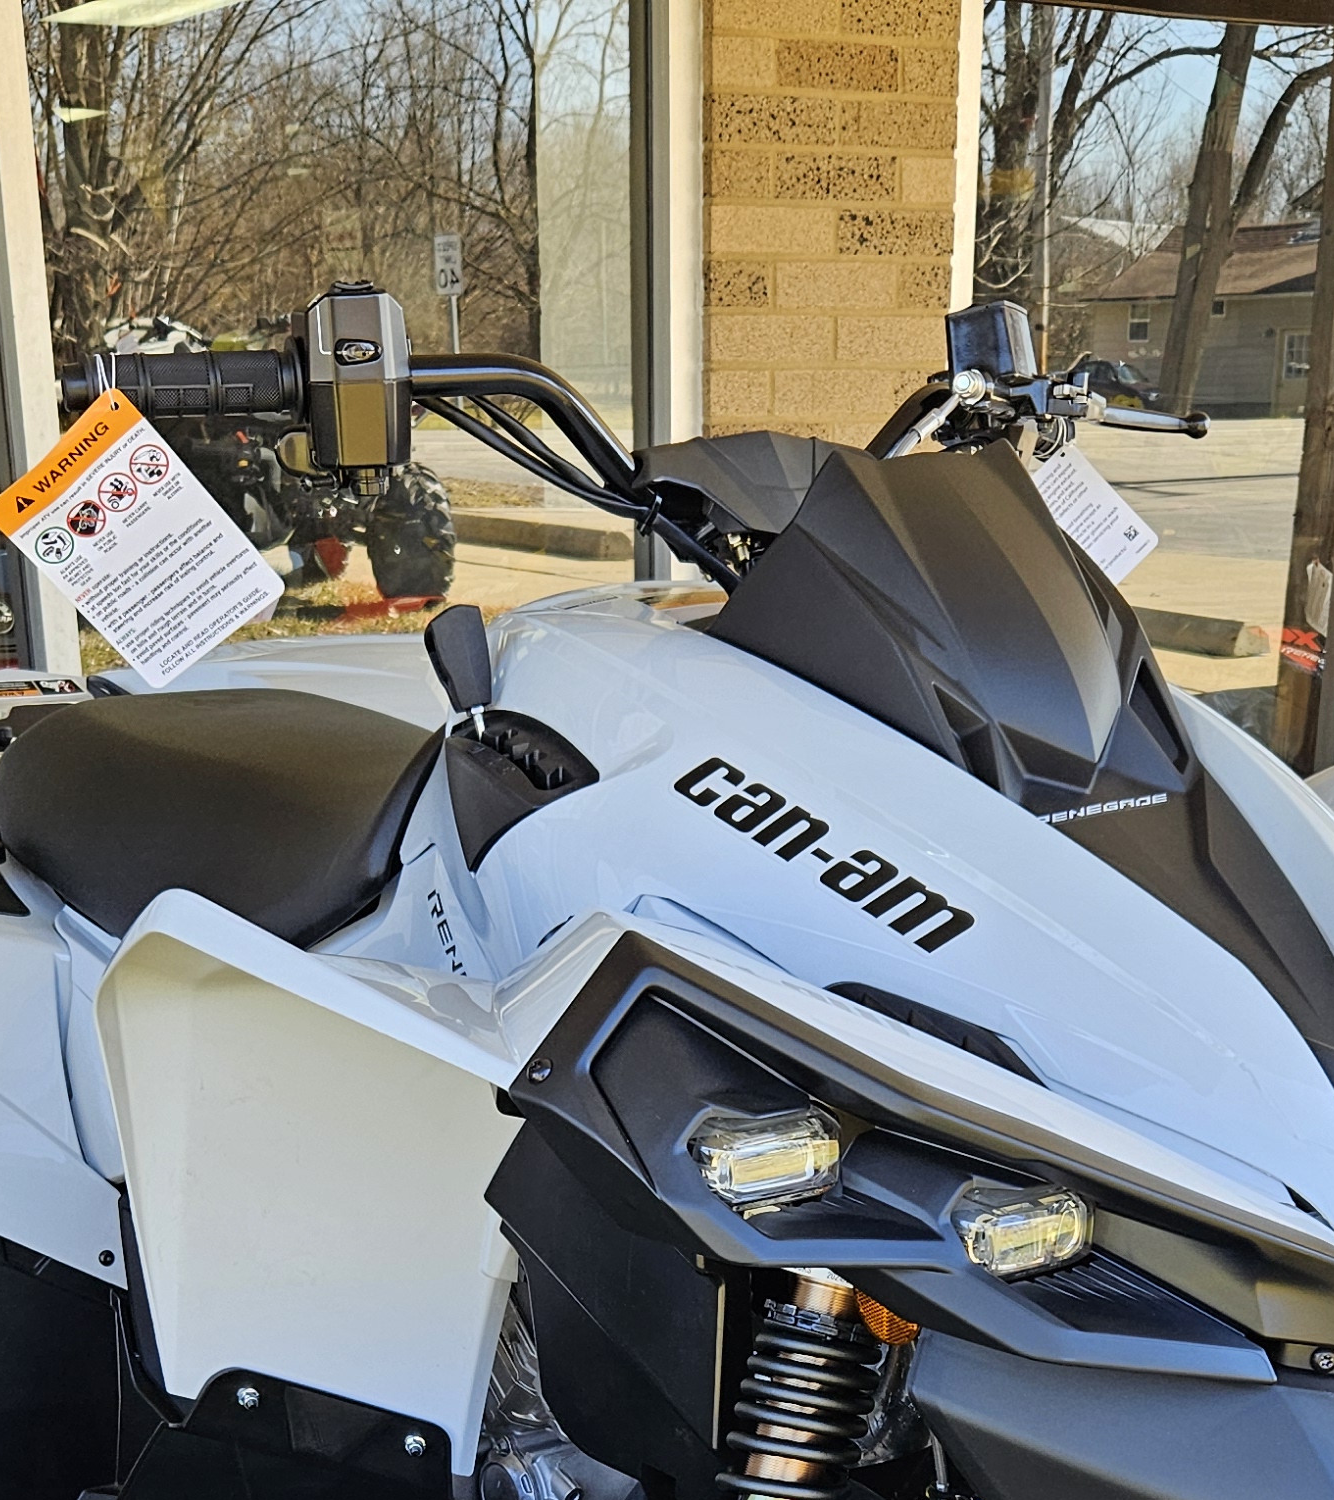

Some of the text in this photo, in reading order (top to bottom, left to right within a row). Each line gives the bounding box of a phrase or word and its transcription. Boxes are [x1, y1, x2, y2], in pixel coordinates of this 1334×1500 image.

[31, 419, 109, 493] WARNING
[158, 585, 262, 668] LOCATE AND READ OPERATOR'S GUIDE.
[161, 589, 270, 676] FOLLOW ALL INSTRUCTIONS WARNINGS.
[1036, 793, 1168, 824] RENEGADE
[673, 757, 975, 953] can-am
[427, 888, 468, 977] REN
